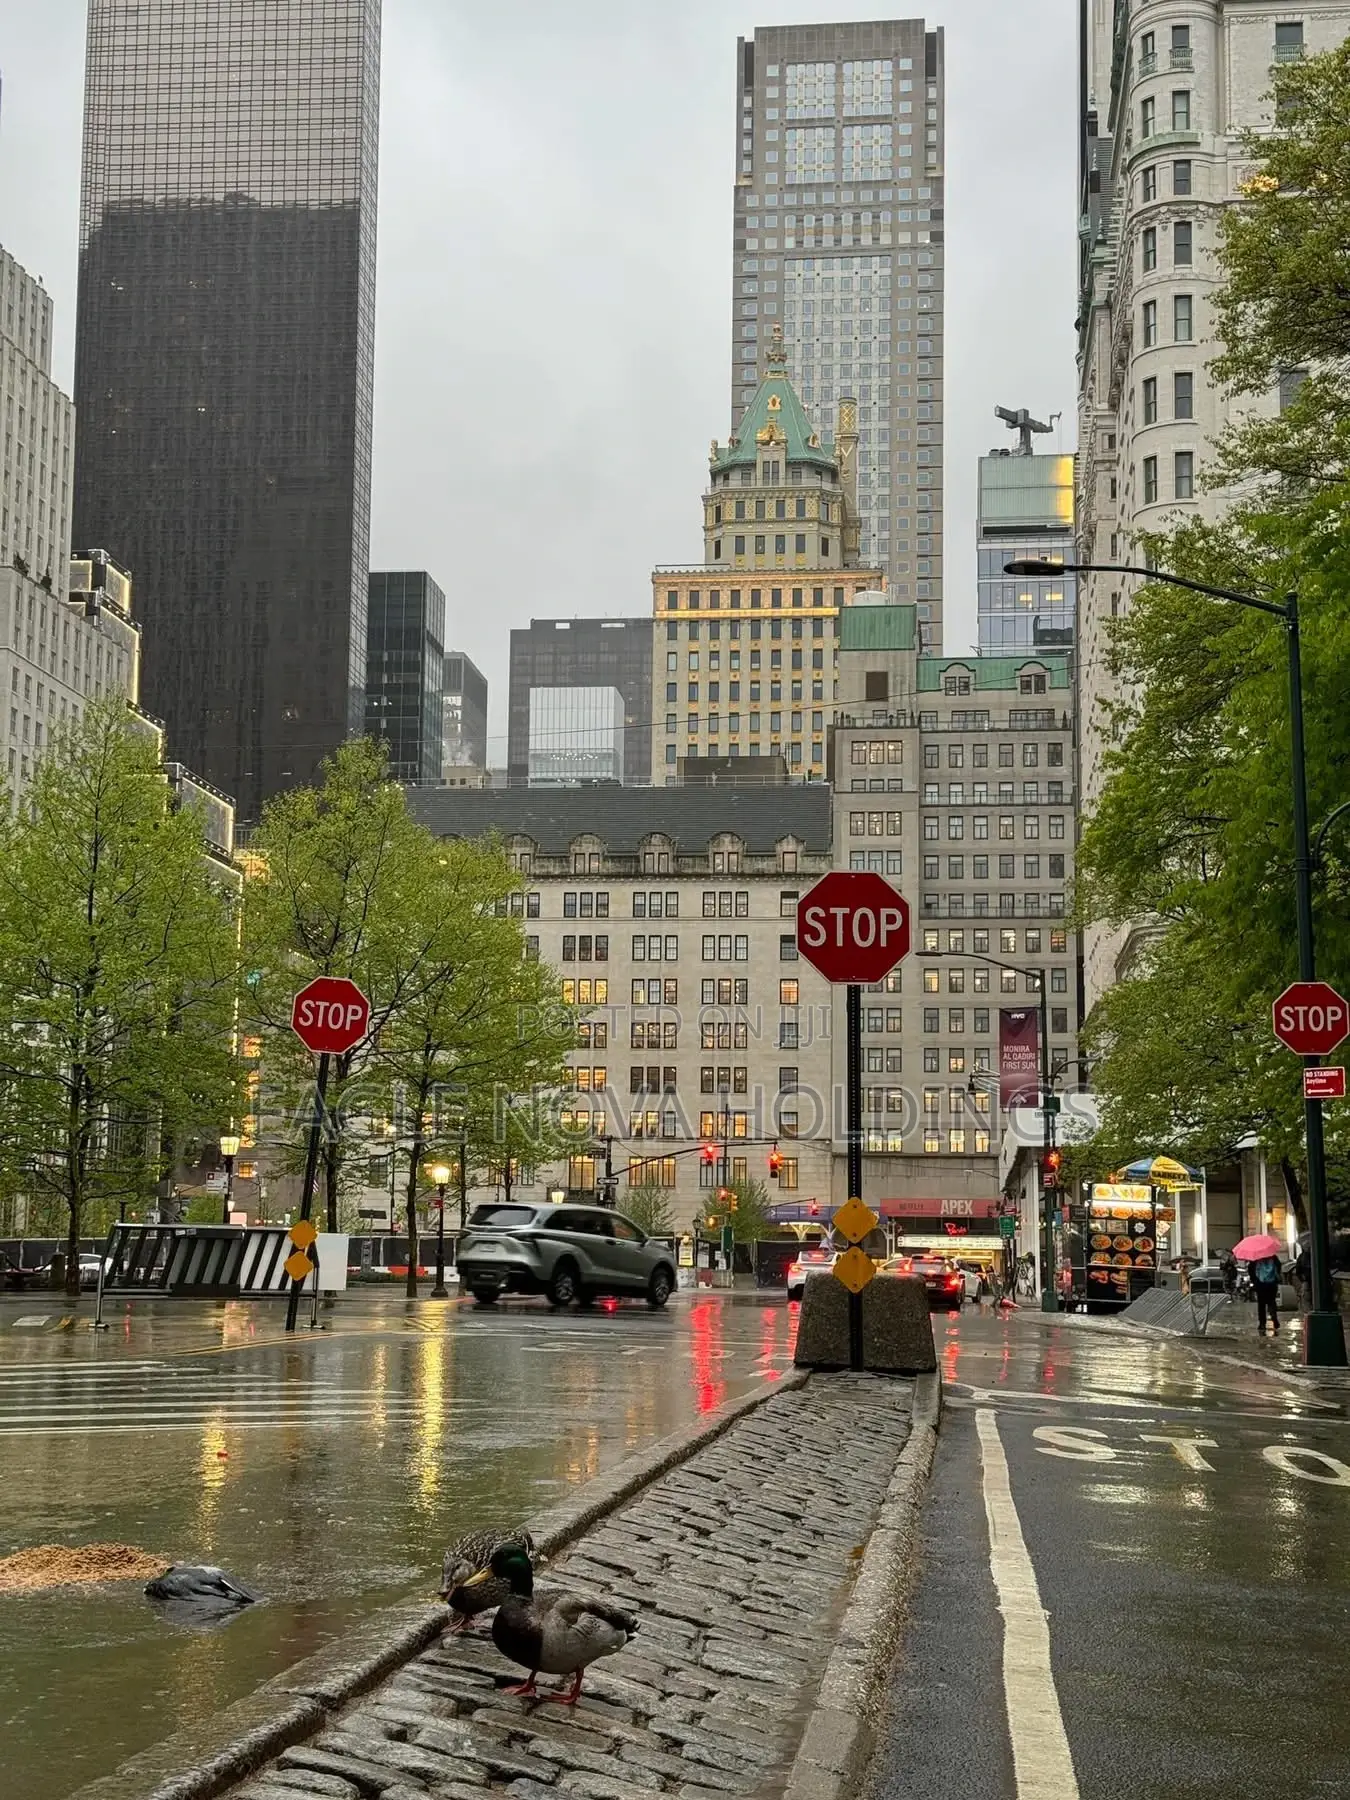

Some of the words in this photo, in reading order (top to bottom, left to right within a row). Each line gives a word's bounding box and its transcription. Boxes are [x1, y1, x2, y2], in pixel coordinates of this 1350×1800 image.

[804, 906, 903, 948] STOP
[298, 999, 363, 1031] STOP
[1279, 1005, 1342, 1032] STOP
[1002, 1061, 1020, 1069] FIRST
[1021, 1061, 1036, 1069] SUN
[1003, 1052, 1011, 1060] AL
[1012, 1052, 1035, 1060] QADIRI
[941, 1200, 973, 1215] APEX
